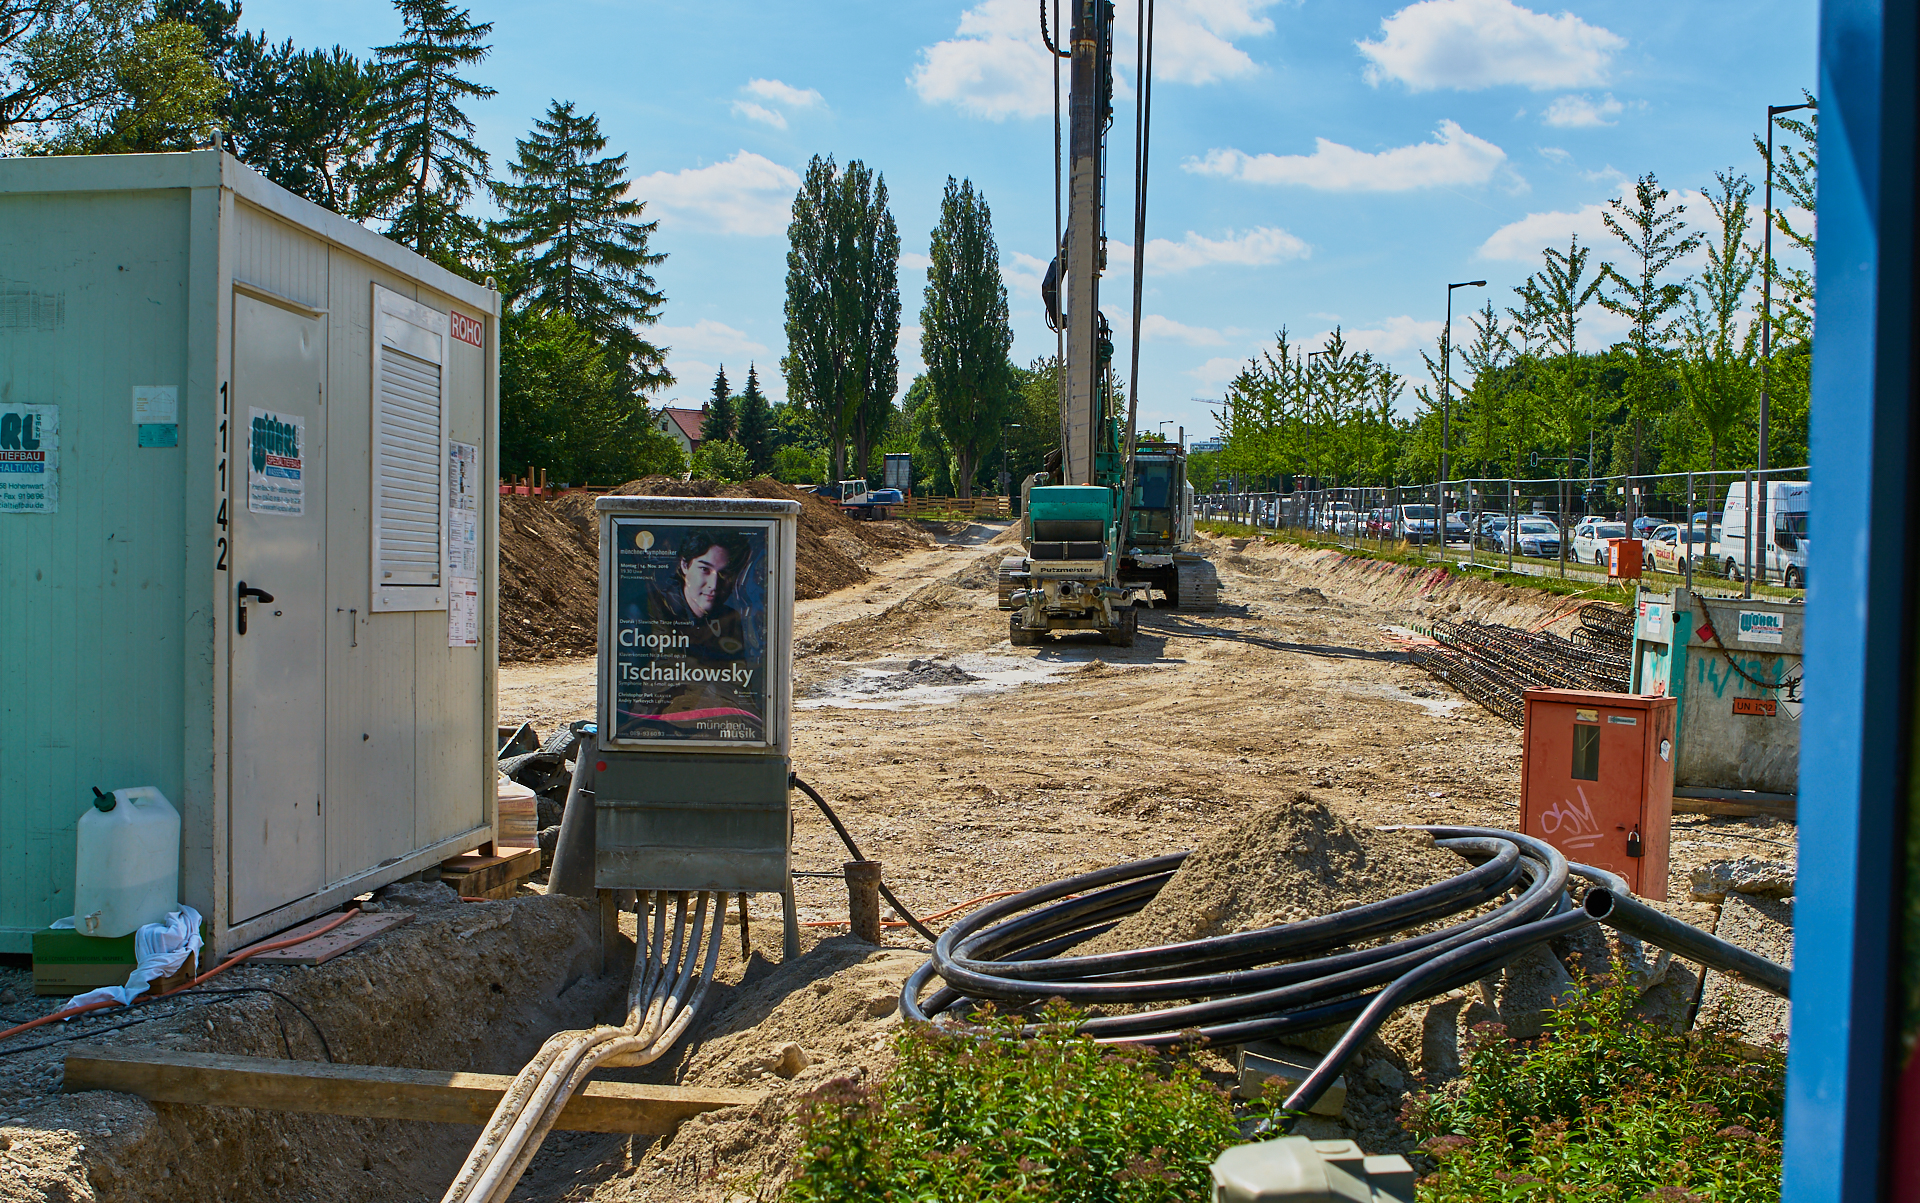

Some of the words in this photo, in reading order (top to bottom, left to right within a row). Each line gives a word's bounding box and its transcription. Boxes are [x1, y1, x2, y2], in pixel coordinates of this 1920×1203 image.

[451, 312, 482, 347] ROHO
[8, 482, 44, 490] Hohenwart
[4, 492, 15, 500] Fax
[1040, 566, 1093, 574] Putzmeister
[1740, 612, 1780, 632] WÖHRL
[618, 627, 690, 653] Chopin
[618, 661, 754, 688] Tschaikowsky
[1737, 701, 1751, 711] UN
[696, 719, 746, 730] münchen
[720, 728, 756, 738] musik
